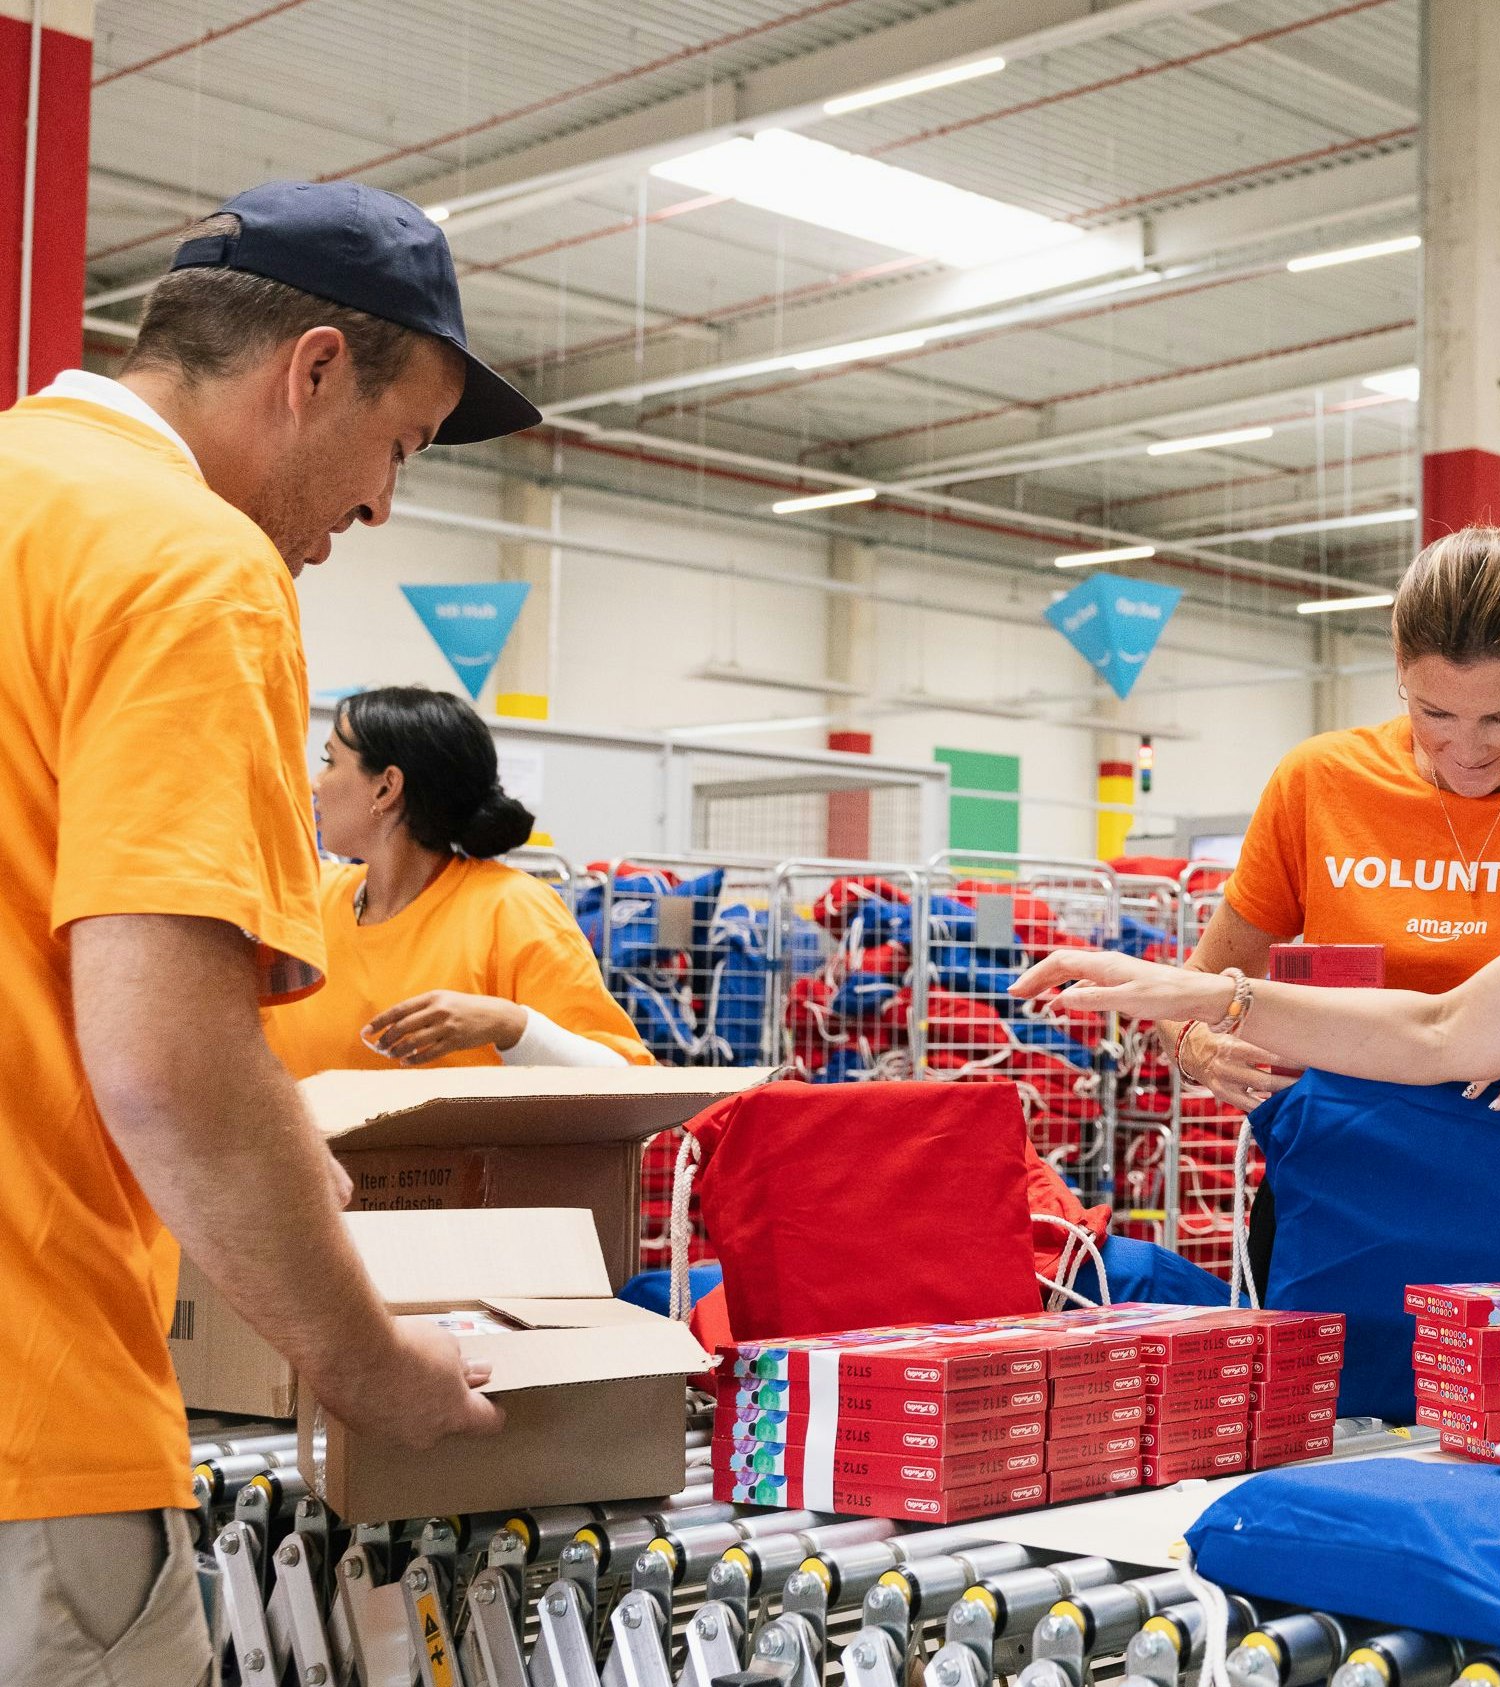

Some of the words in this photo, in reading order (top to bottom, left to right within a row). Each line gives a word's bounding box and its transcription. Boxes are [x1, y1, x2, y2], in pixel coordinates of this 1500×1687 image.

[1406, 918, 1488, 936] amazon
[399, 1168, 452, 1188] 6571007
[847, 1365, 871, 1377] ST12
[847, 1398, 872, 1409] ST12
[845, 1430, 870, 1441] ST12
[843, 1462, 868, 1474] ST12
[847, 1494, 871, 1506] ST12
